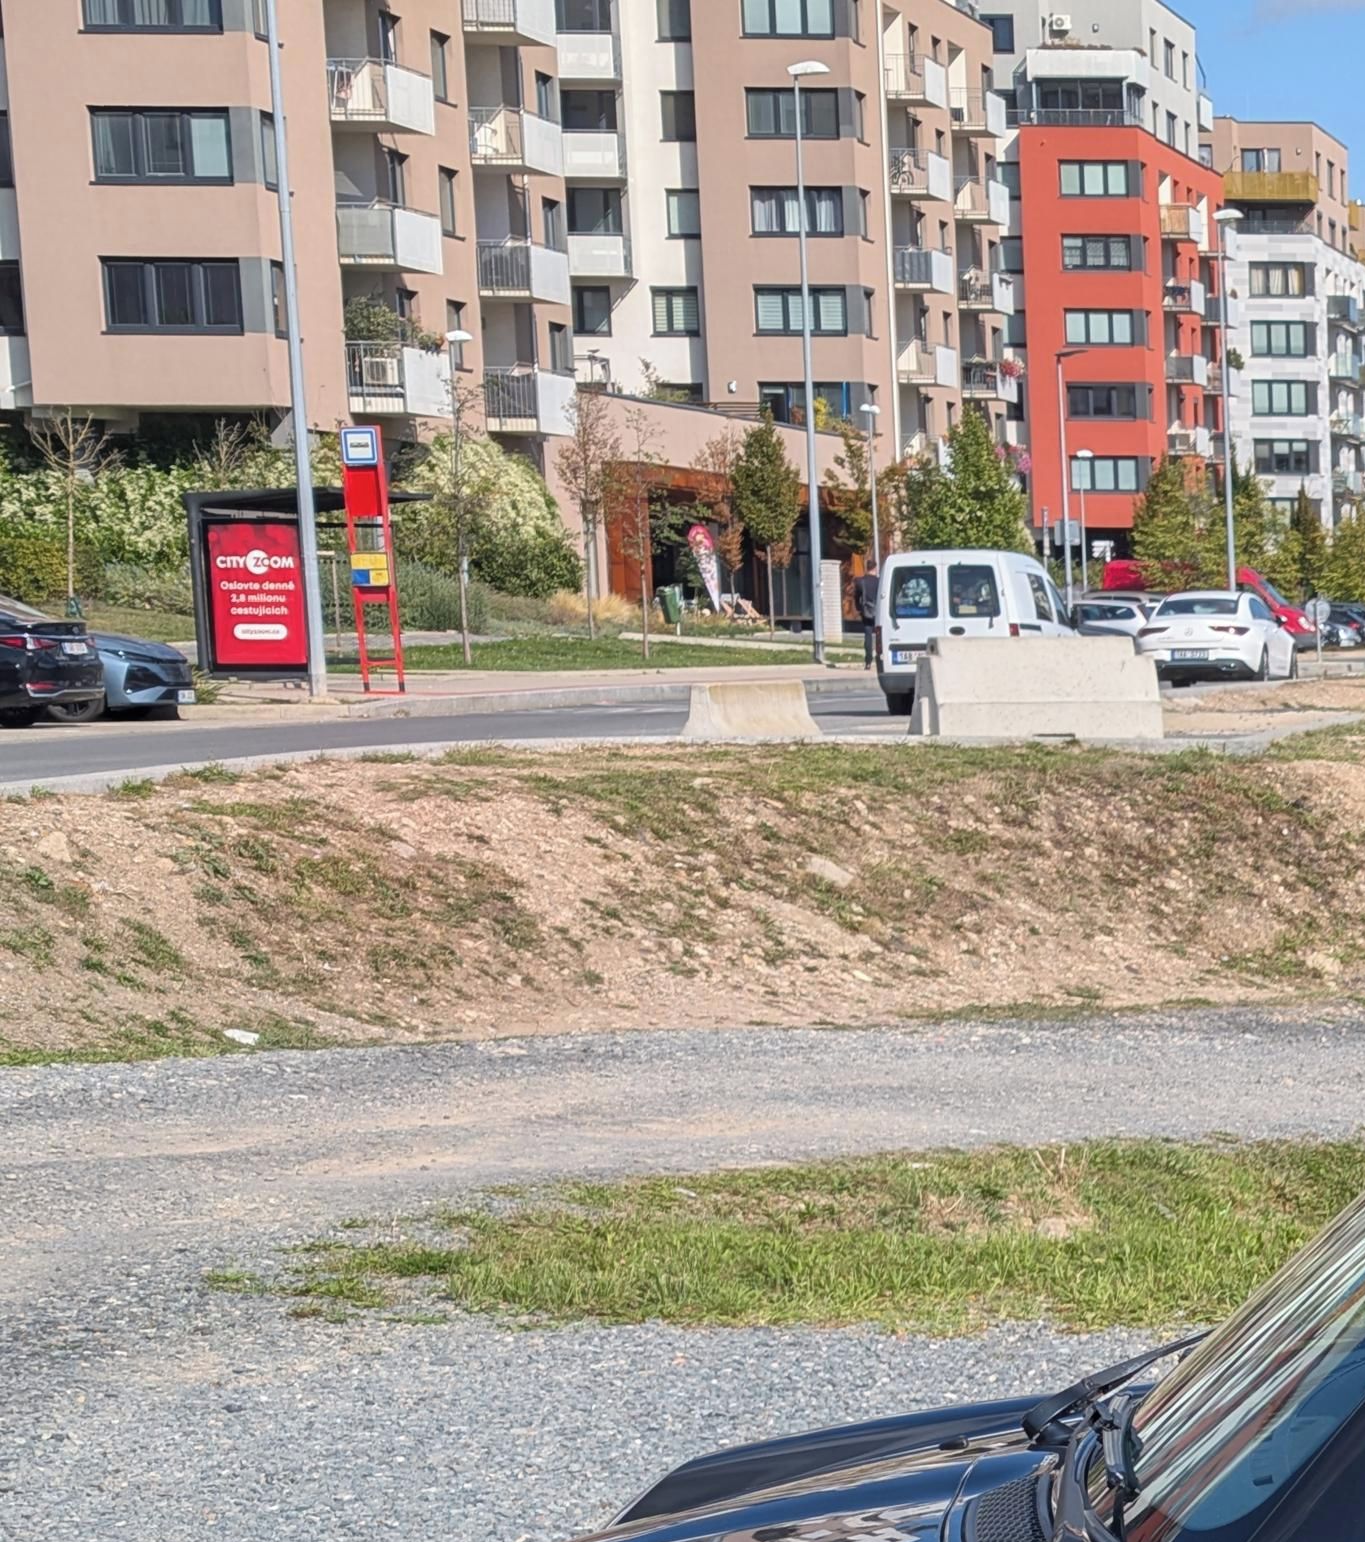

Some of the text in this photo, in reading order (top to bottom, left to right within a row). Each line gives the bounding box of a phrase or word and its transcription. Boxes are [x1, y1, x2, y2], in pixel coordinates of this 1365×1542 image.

[216, 555, 294, 569] CITYZOOM
[220, 581, 295, 590] Oslovte denně
[247, 593, 286, 603] milionu
